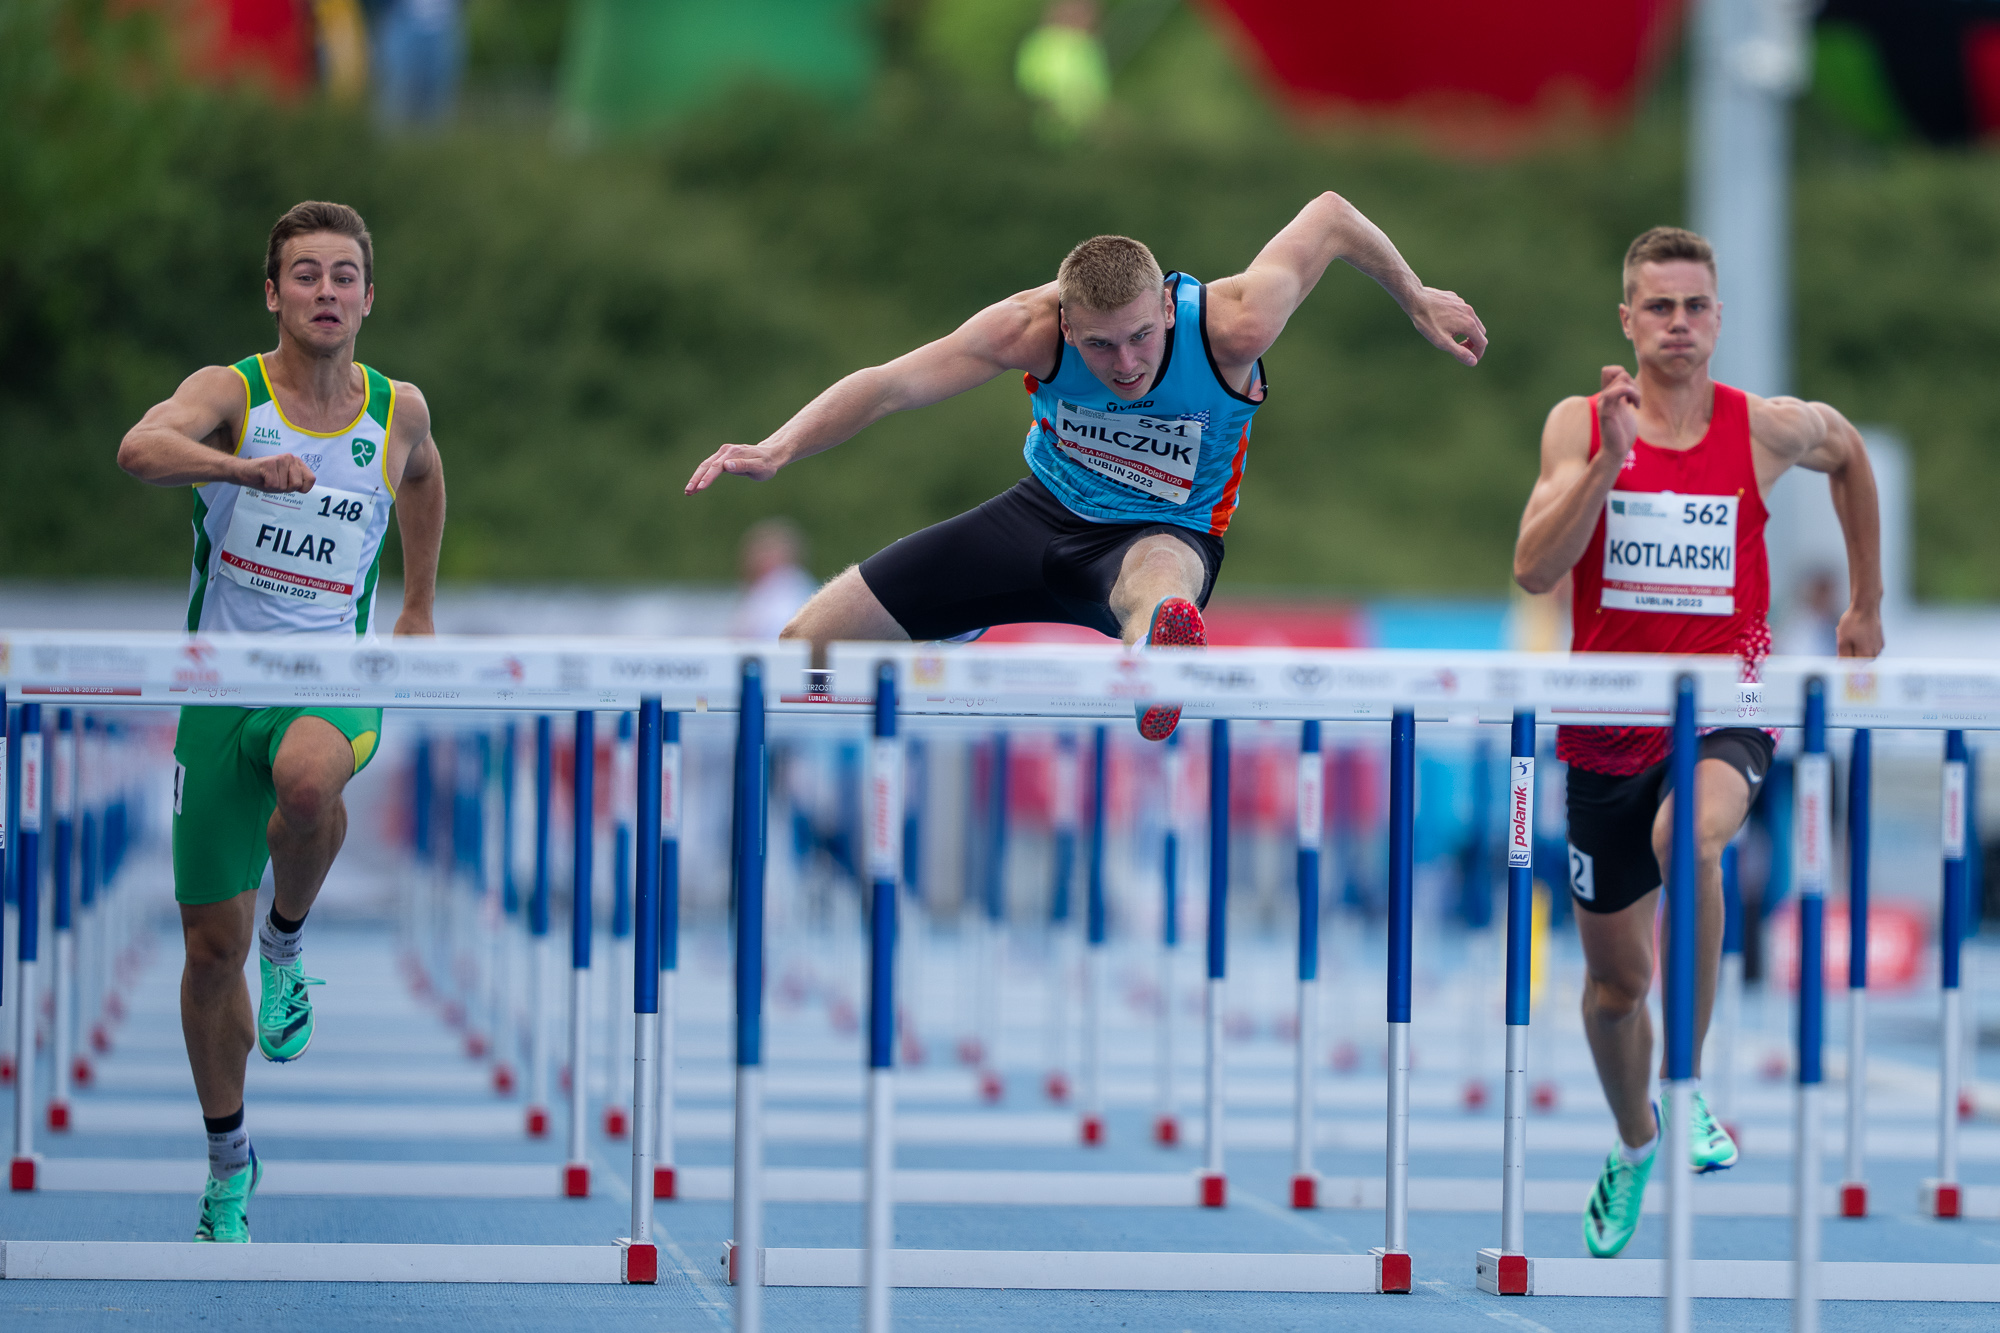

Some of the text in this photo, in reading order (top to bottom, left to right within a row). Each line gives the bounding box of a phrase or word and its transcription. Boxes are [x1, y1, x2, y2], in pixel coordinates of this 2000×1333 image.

[254, 426, 281, 440] ZLKL
[1062, 418, 1193, 466] MILCZUK
[1138, 418, 1188, 438] 561
[1065, 440, 1076, 448] 77.
[1095, 450, 1143, 471] Mistrzostwa
[1143, 467, 1166, 480] Polski
[1166, 475, 1183, 486] U20
[1088, 457, 1154, 488] LUBLIN 2023
[317, 495, 364, 522] 148
[1683, 502, 1728, 526] 562
[255, 523, 336, 565] FILAR
[1609, 539, 1731, 571] KOTLARSKI
[229, 555, 346, 593] 77. PZLA Mistrzostwa Polski U20
[249, 576, 317, 600] LUBLIN 2023
[1635, 596, 1703, 607] LUBLIN 2023
[1512, 785, 1528, 848] polanik
[1573, 852, 1586, 893] 2
